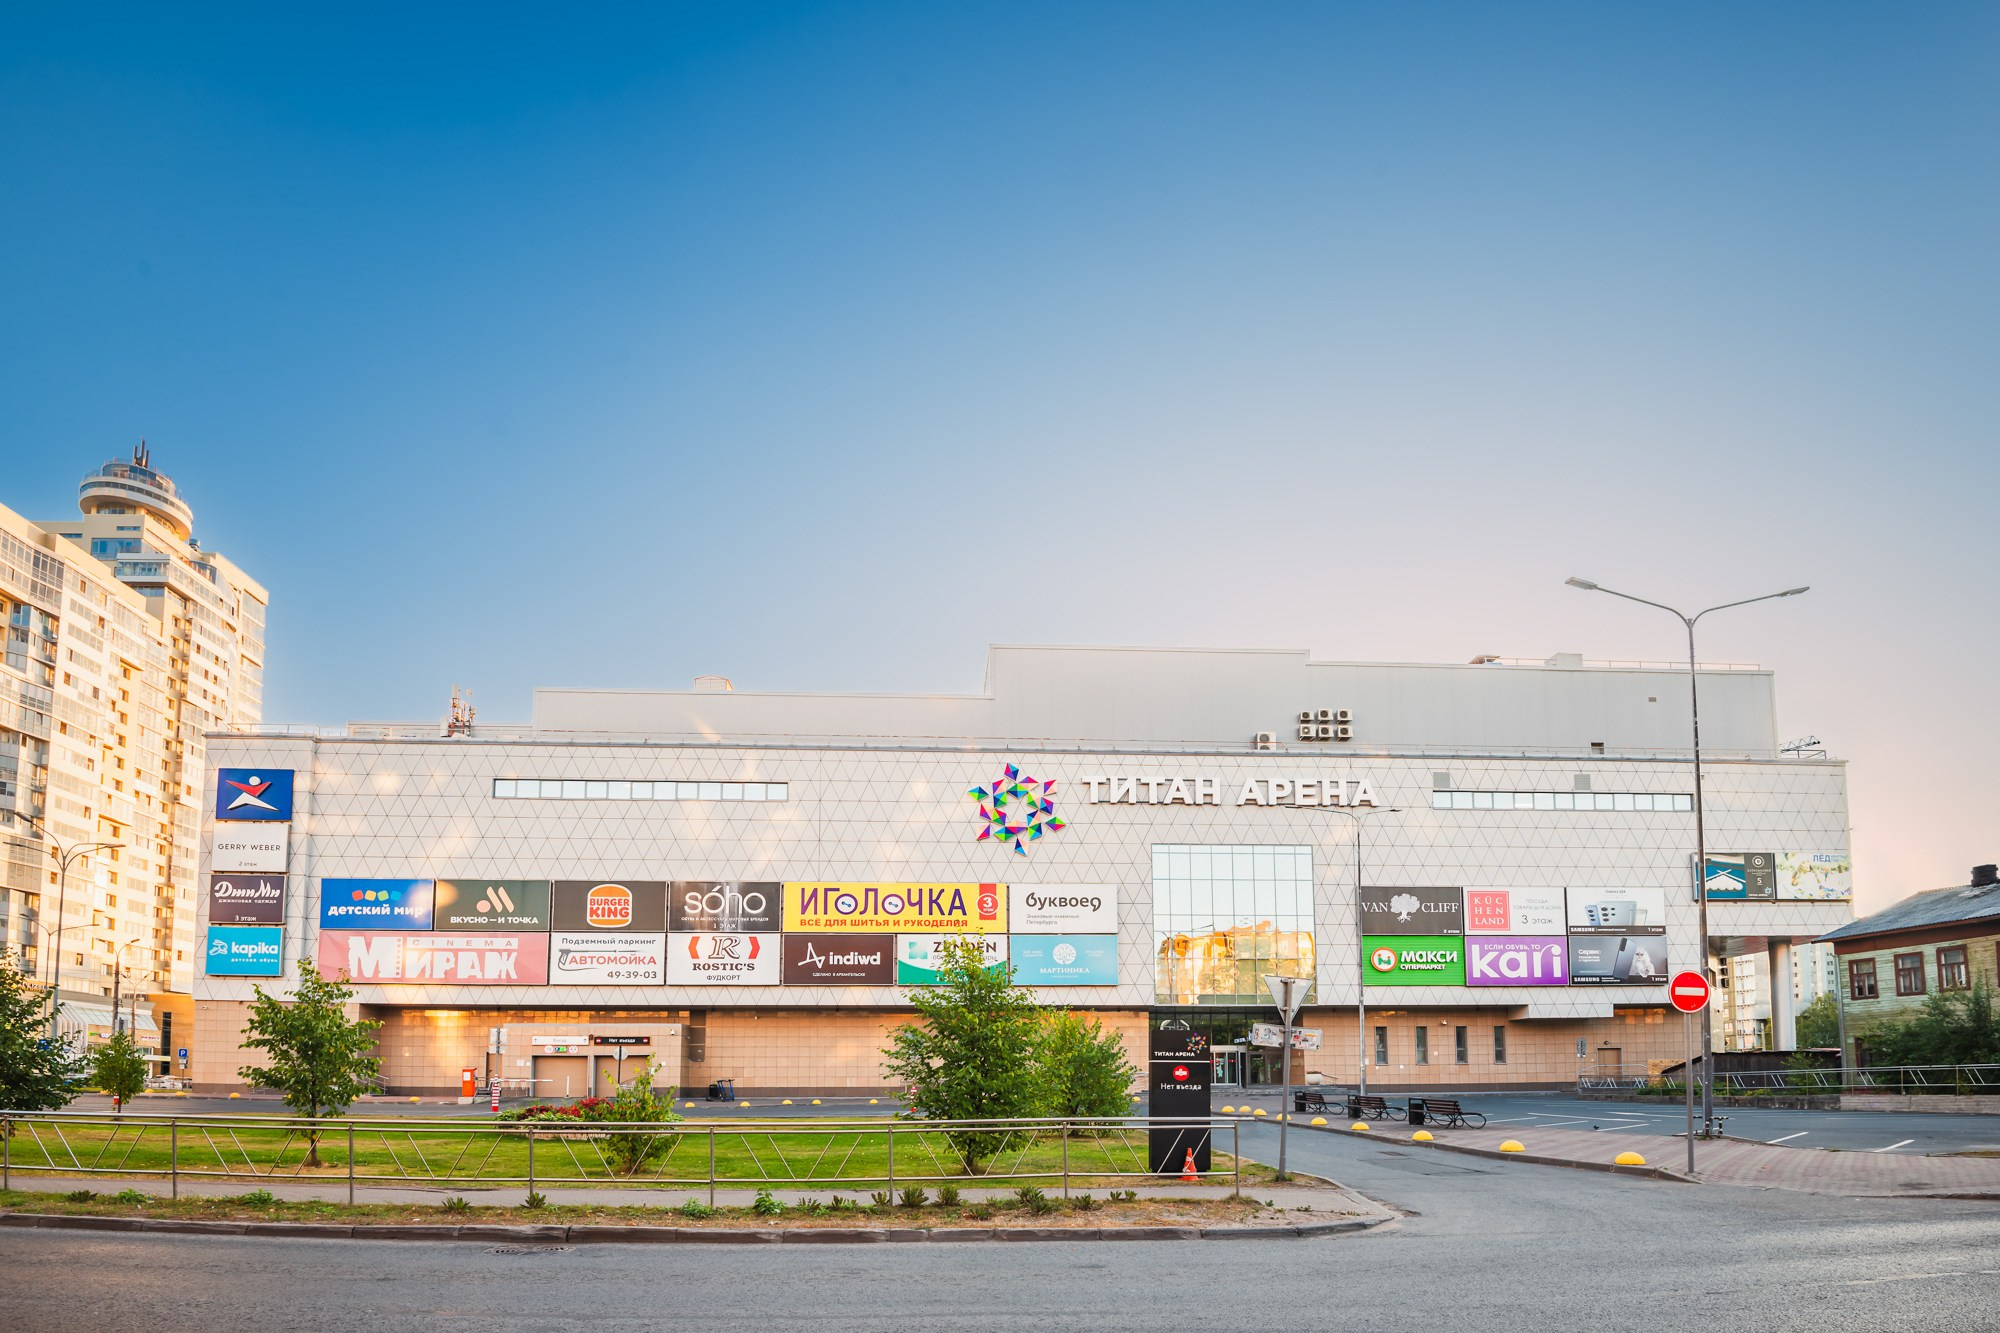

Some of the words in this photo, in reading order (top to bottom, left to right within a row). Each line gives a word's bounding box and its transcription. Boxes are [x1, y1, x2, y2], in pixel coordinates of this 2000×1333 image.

[1081, 776, 1221, 805] ТИТАН
[1235, 777, 1381, 807] АРЕНА
[589, 898, 630, 907] BURGER
[800, 887, 968, 916] ИГОЛОЧКА
[983, 896, 993, 908] 3
[328, 904, 391, 916] детский
[394, 906, 424, 917] мир
[589, 907, 630, 918] KING
[1361, 902, 1388, 912] VAN
[1421, 902, 1459, 913] CLIFF
[507, 916, 539, 924] ТОЧКА
[800, 918, 821, 927] ВСЁ
[824, 919, 847, 928] ДЛЯ
[850, 919, 889, 927] ШИТЬЯ
[893, 919, 900, 927] И
[904, 919, 968, 928] РУКОДЕЛИЯ
[1475, 917, 1505, 925] LAND
[1521, 914, 1528, 924] 3
[413, 939, 512, 947] CINEMA
[562, 937, 616, 945] Подземный
[231, 941, 279, 958] kapika
[348, 936, 518, 979] МИРАЖ
[569, 953, 657, 965] АВТОМОЙКА
[829, 951, 881, 965] indiwd
[1471, 943, 1562, 978] kari
[692, 963, 755, 971] ROSTIC'S
[607, 971, 657, 979] 49-39-03
[1160, 1082, 1175, 1090] Нет
